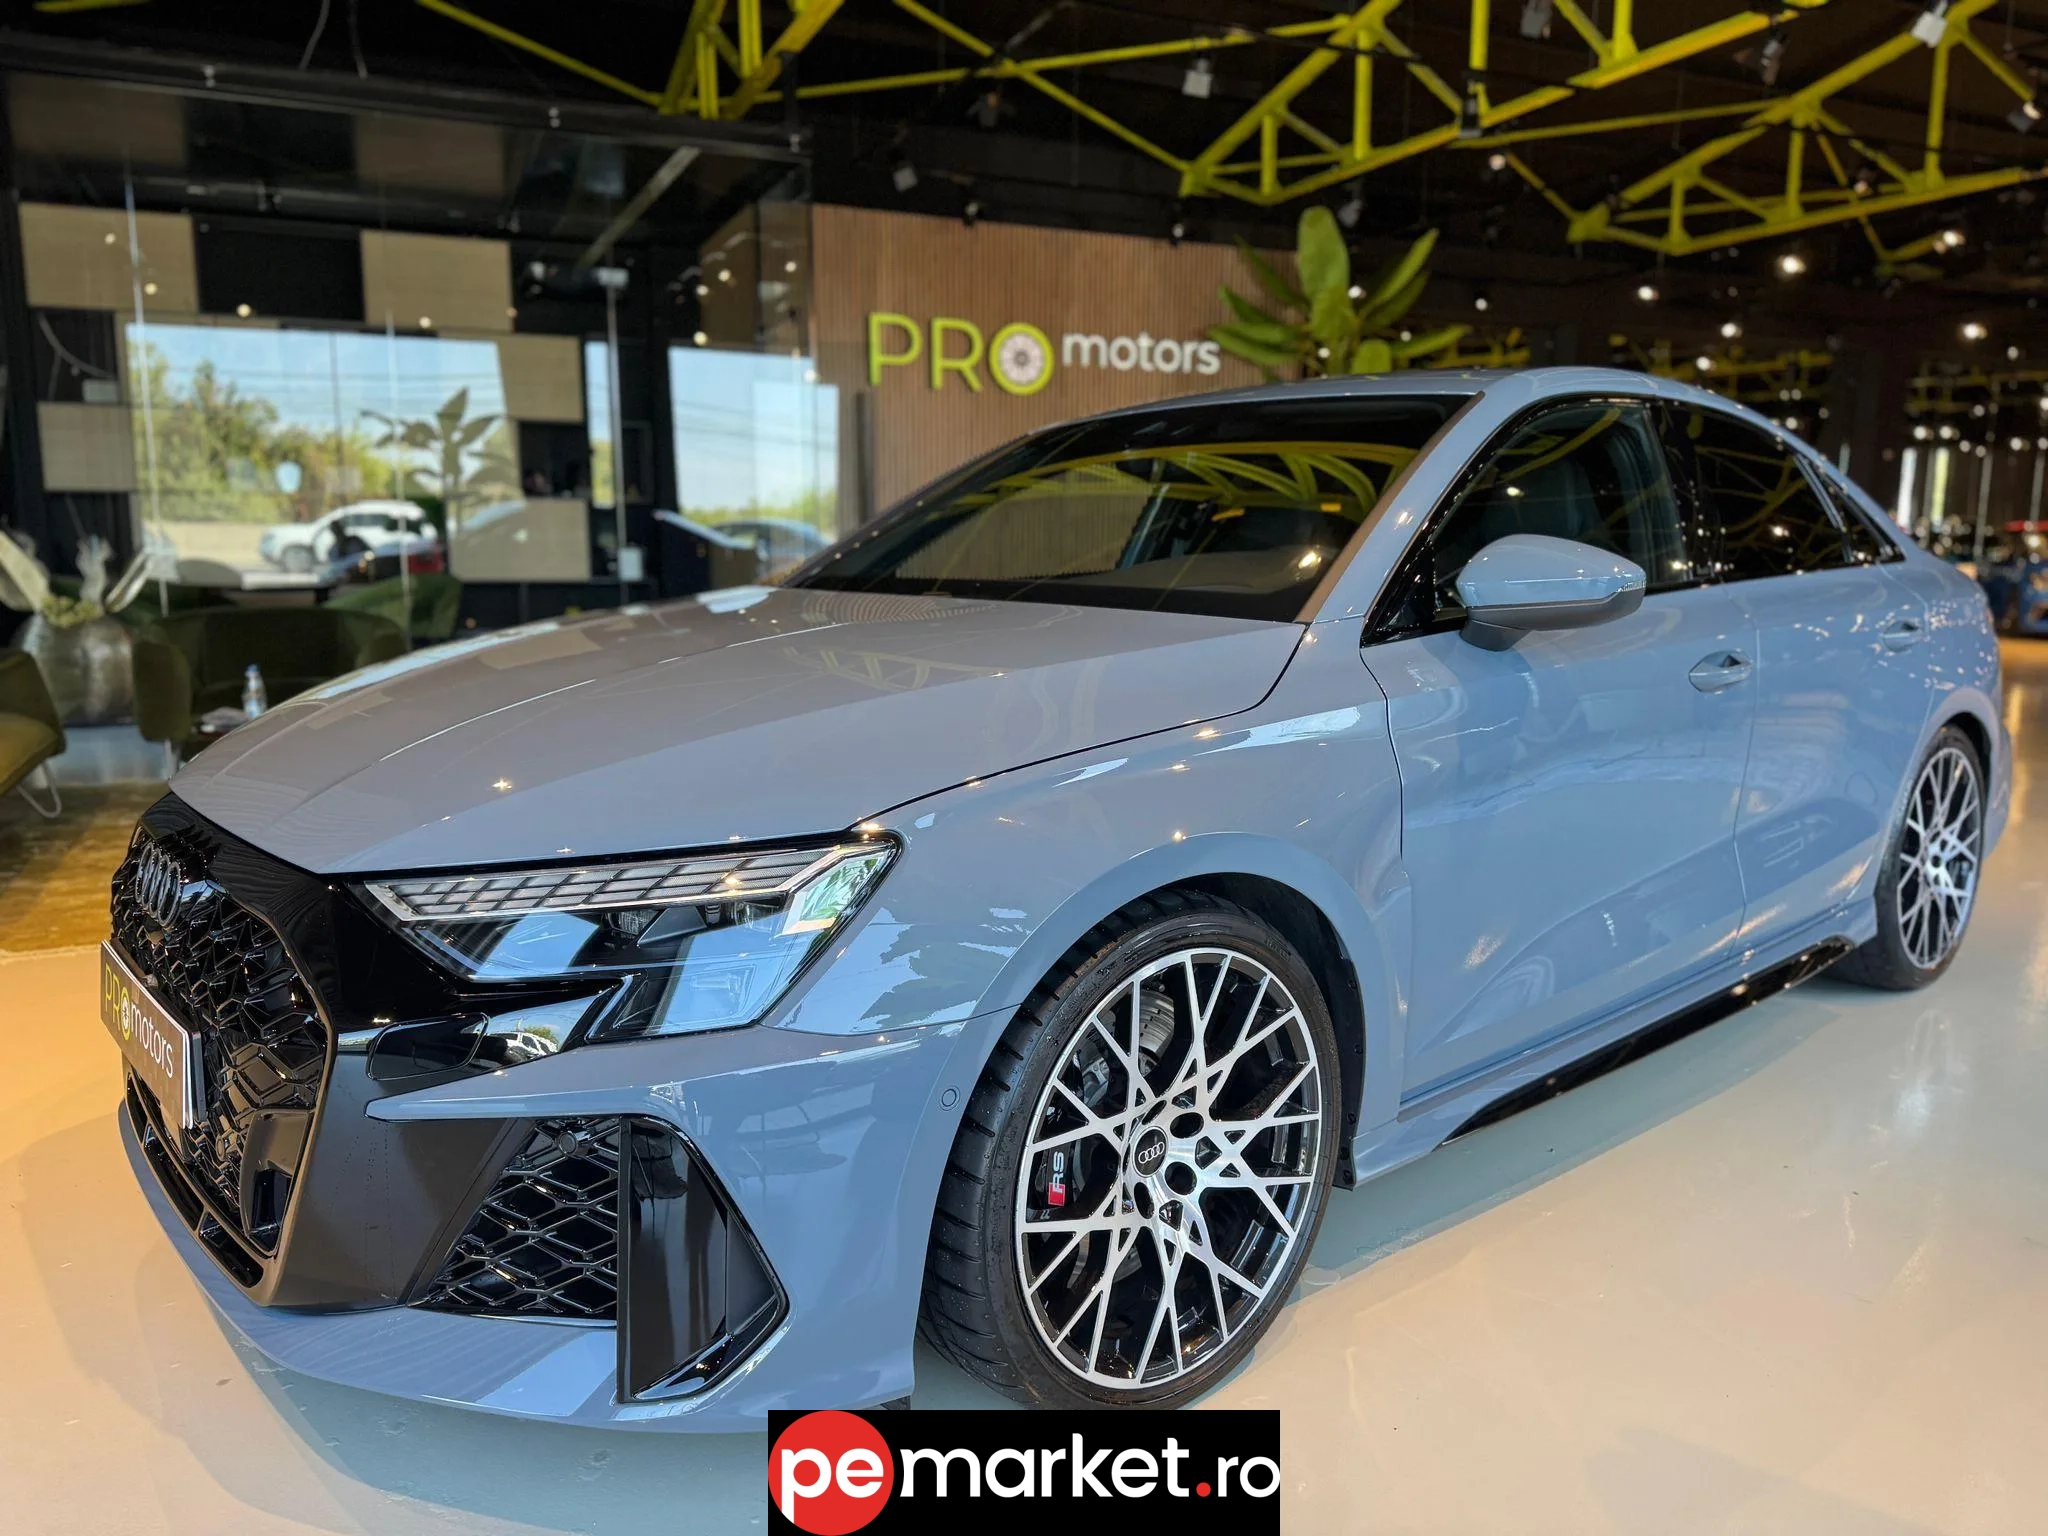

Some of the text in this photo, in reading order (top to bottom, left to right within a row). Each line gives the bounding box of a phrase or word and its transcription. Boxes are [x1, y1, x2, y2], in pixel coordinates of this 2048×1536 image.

[1062, 331, 1221, 375] motors
[131, 999, 174, 1079] motors
[1052, 1150, 1065, 1193] RS
